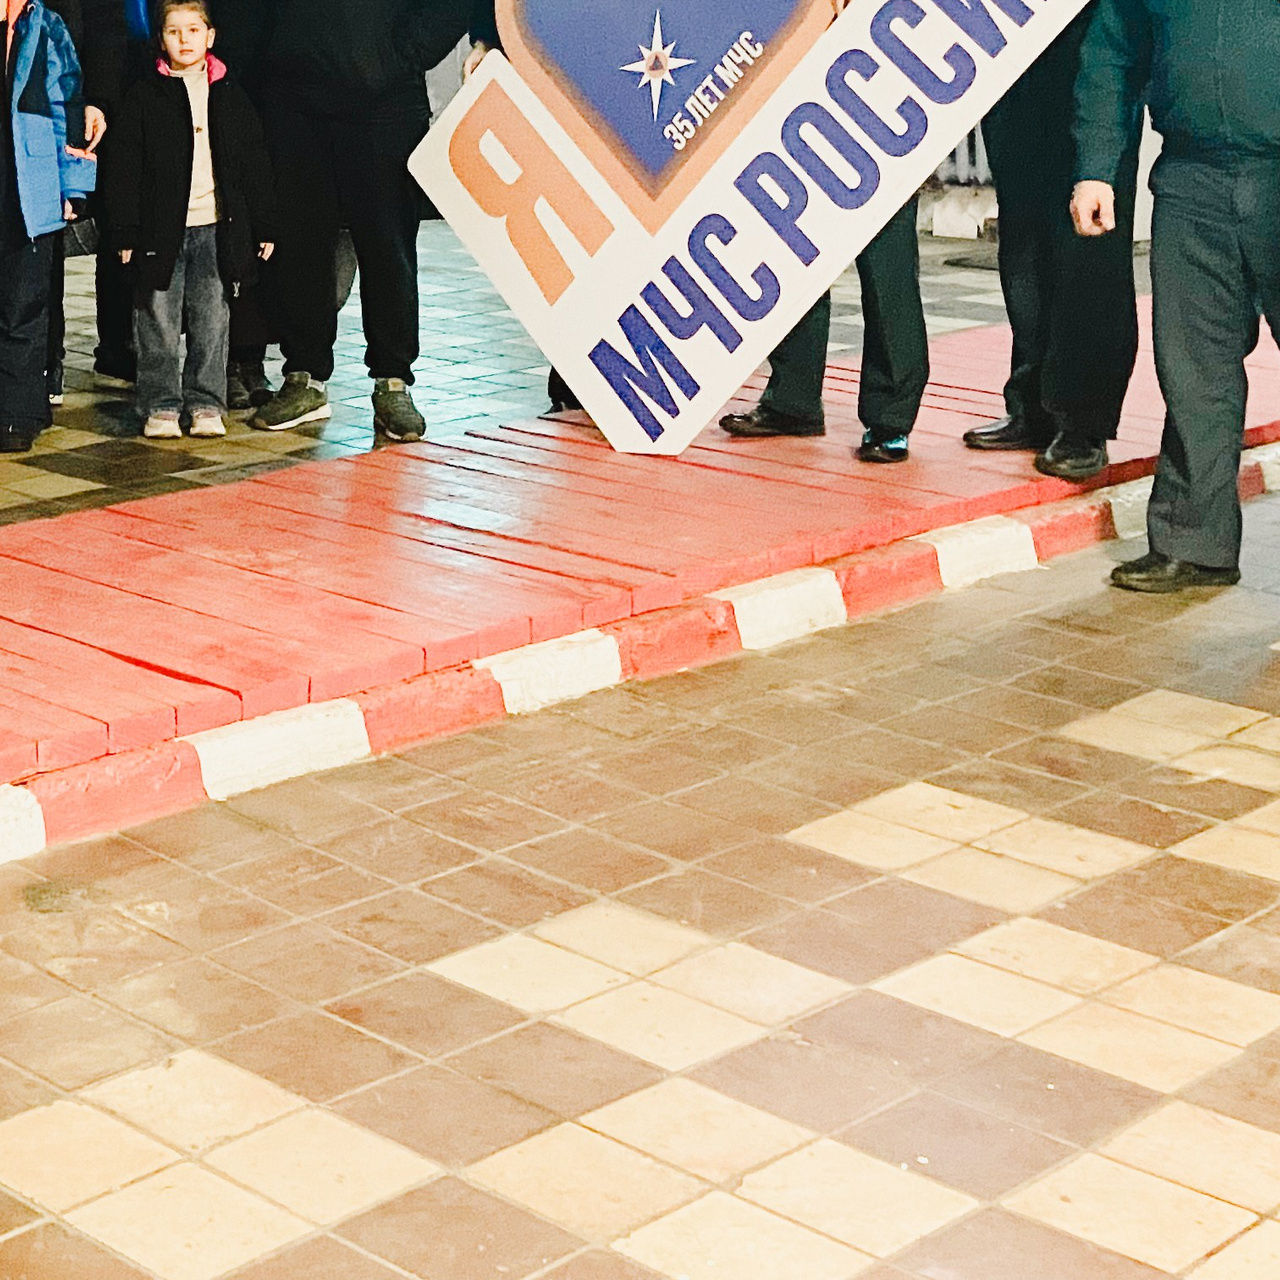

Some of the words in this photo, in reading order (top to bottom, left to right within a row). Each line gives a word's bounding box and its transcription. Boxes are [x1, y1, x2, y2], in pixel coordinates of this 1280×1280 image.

[448, 79, 615, 306] Я
[663, 111, 696, 151] 35
[684, 74, 726, 127] ЛЕТ
[713, 31, 764, 90] МЧС
[587, 212, 781, 443] МЧС
